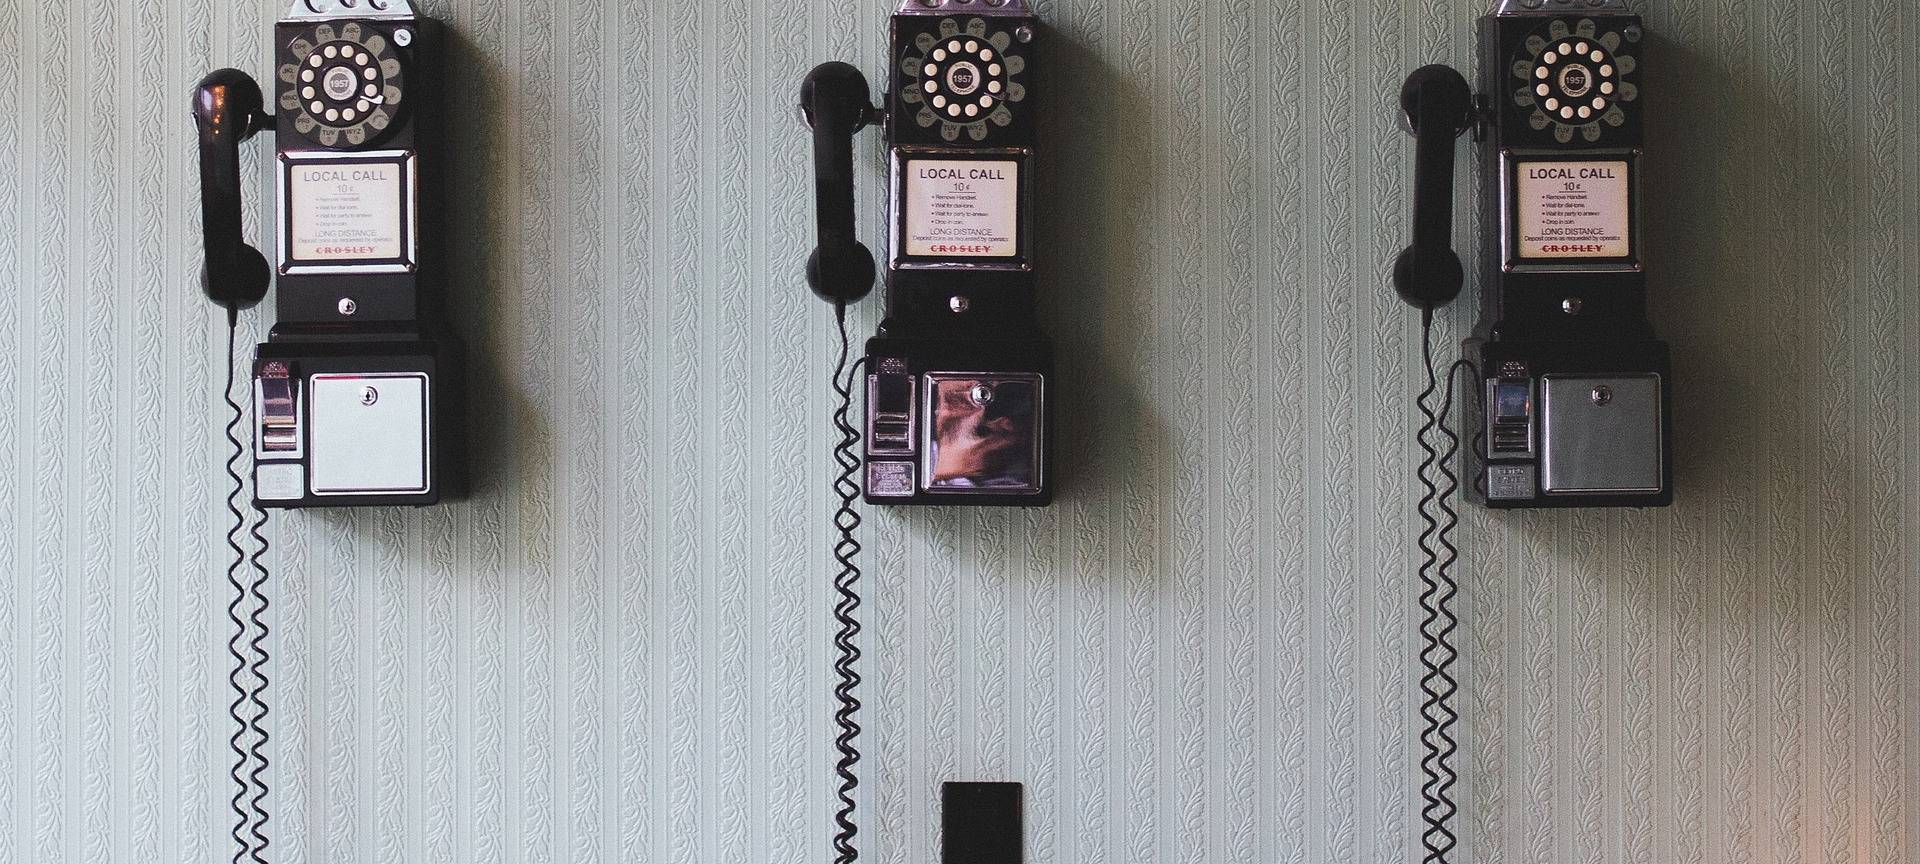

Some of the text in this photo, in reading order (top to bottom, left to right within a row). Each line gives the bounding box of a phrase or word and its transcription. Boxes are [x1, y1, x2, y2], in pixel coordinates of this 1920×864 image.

[304, 171, 387, 181] LOCAL CALL
[920, 169, 1004, 179] LOCAL CALL
[1530, 169, 1615, 179] LOCAL CALL
